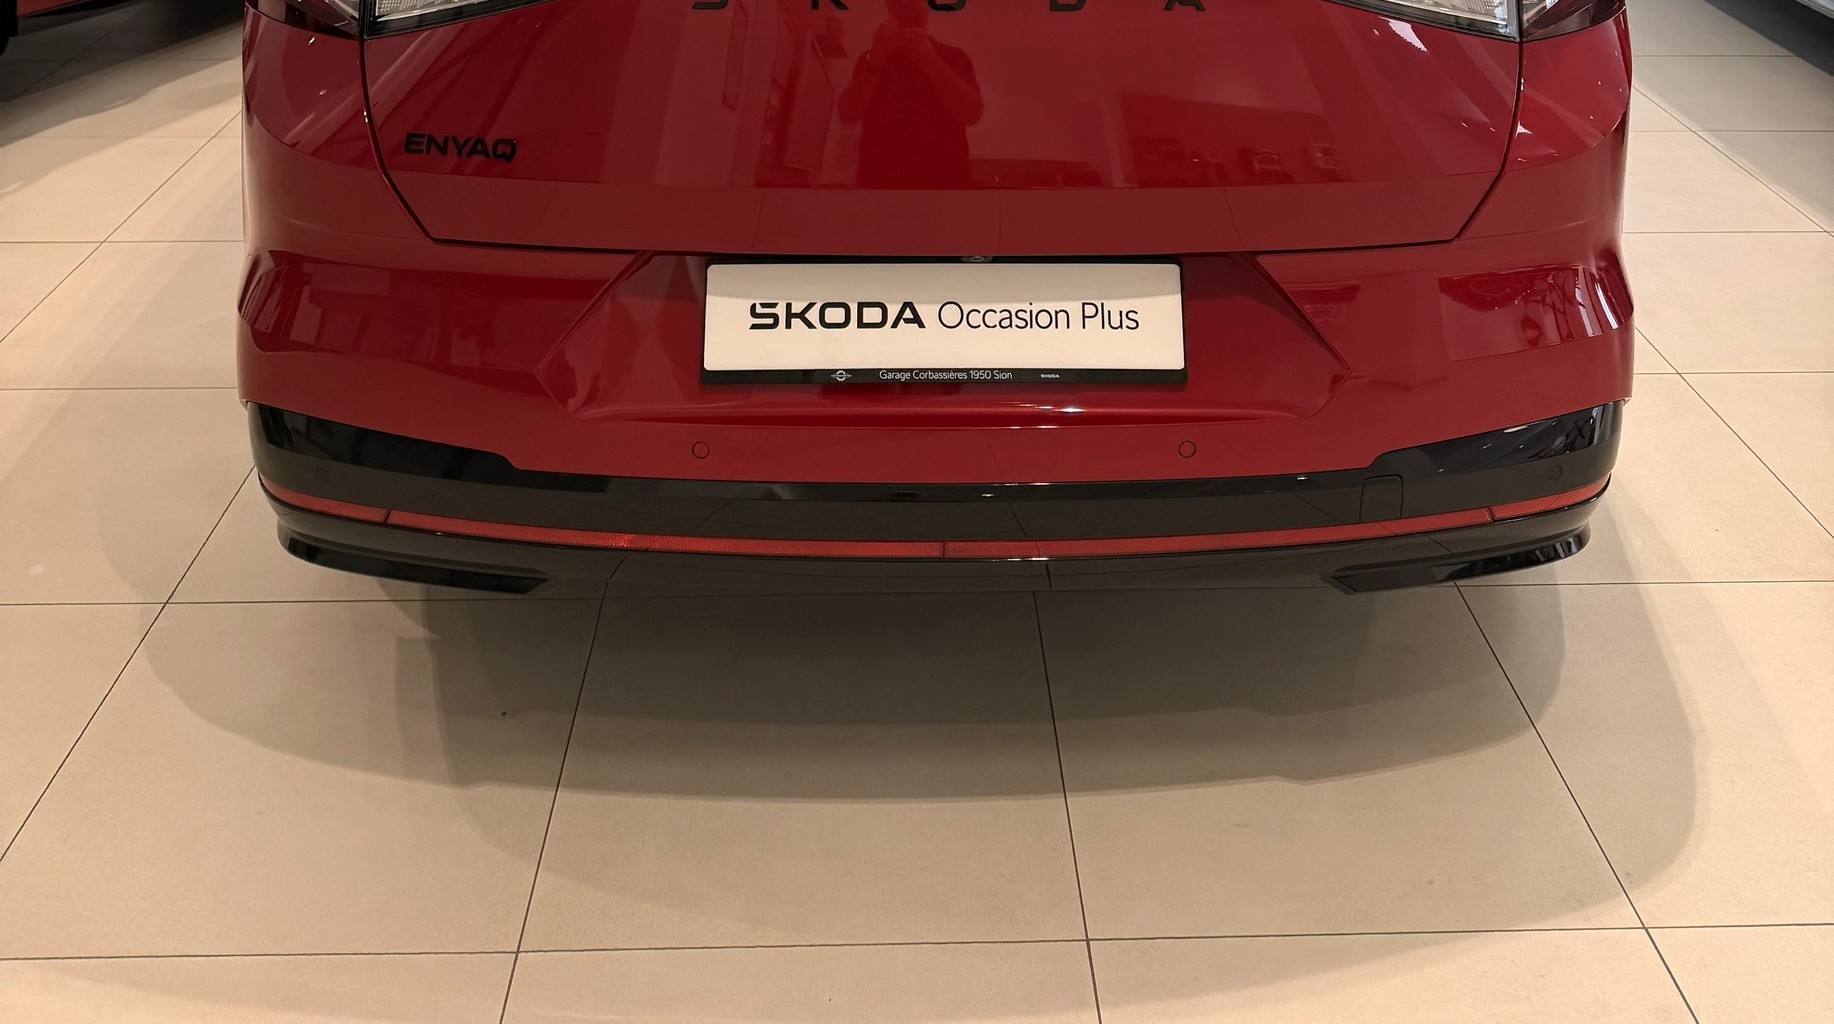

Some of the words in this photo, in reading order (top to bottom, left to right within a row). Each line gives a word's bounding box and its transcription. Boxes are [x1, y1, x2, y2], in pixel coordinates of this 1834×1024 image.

[404, 132, 517, 163] ENYAQ
[938, 301, 1070, 329] Occasion
[1081, 302, 1140, 330] Plus
[879, 370, 911, 381] Garage
[912, 370, 968, 380] Corbassières
[969, 370, 992, 380] 1950
[993, 370, 1013, 380] Sion
